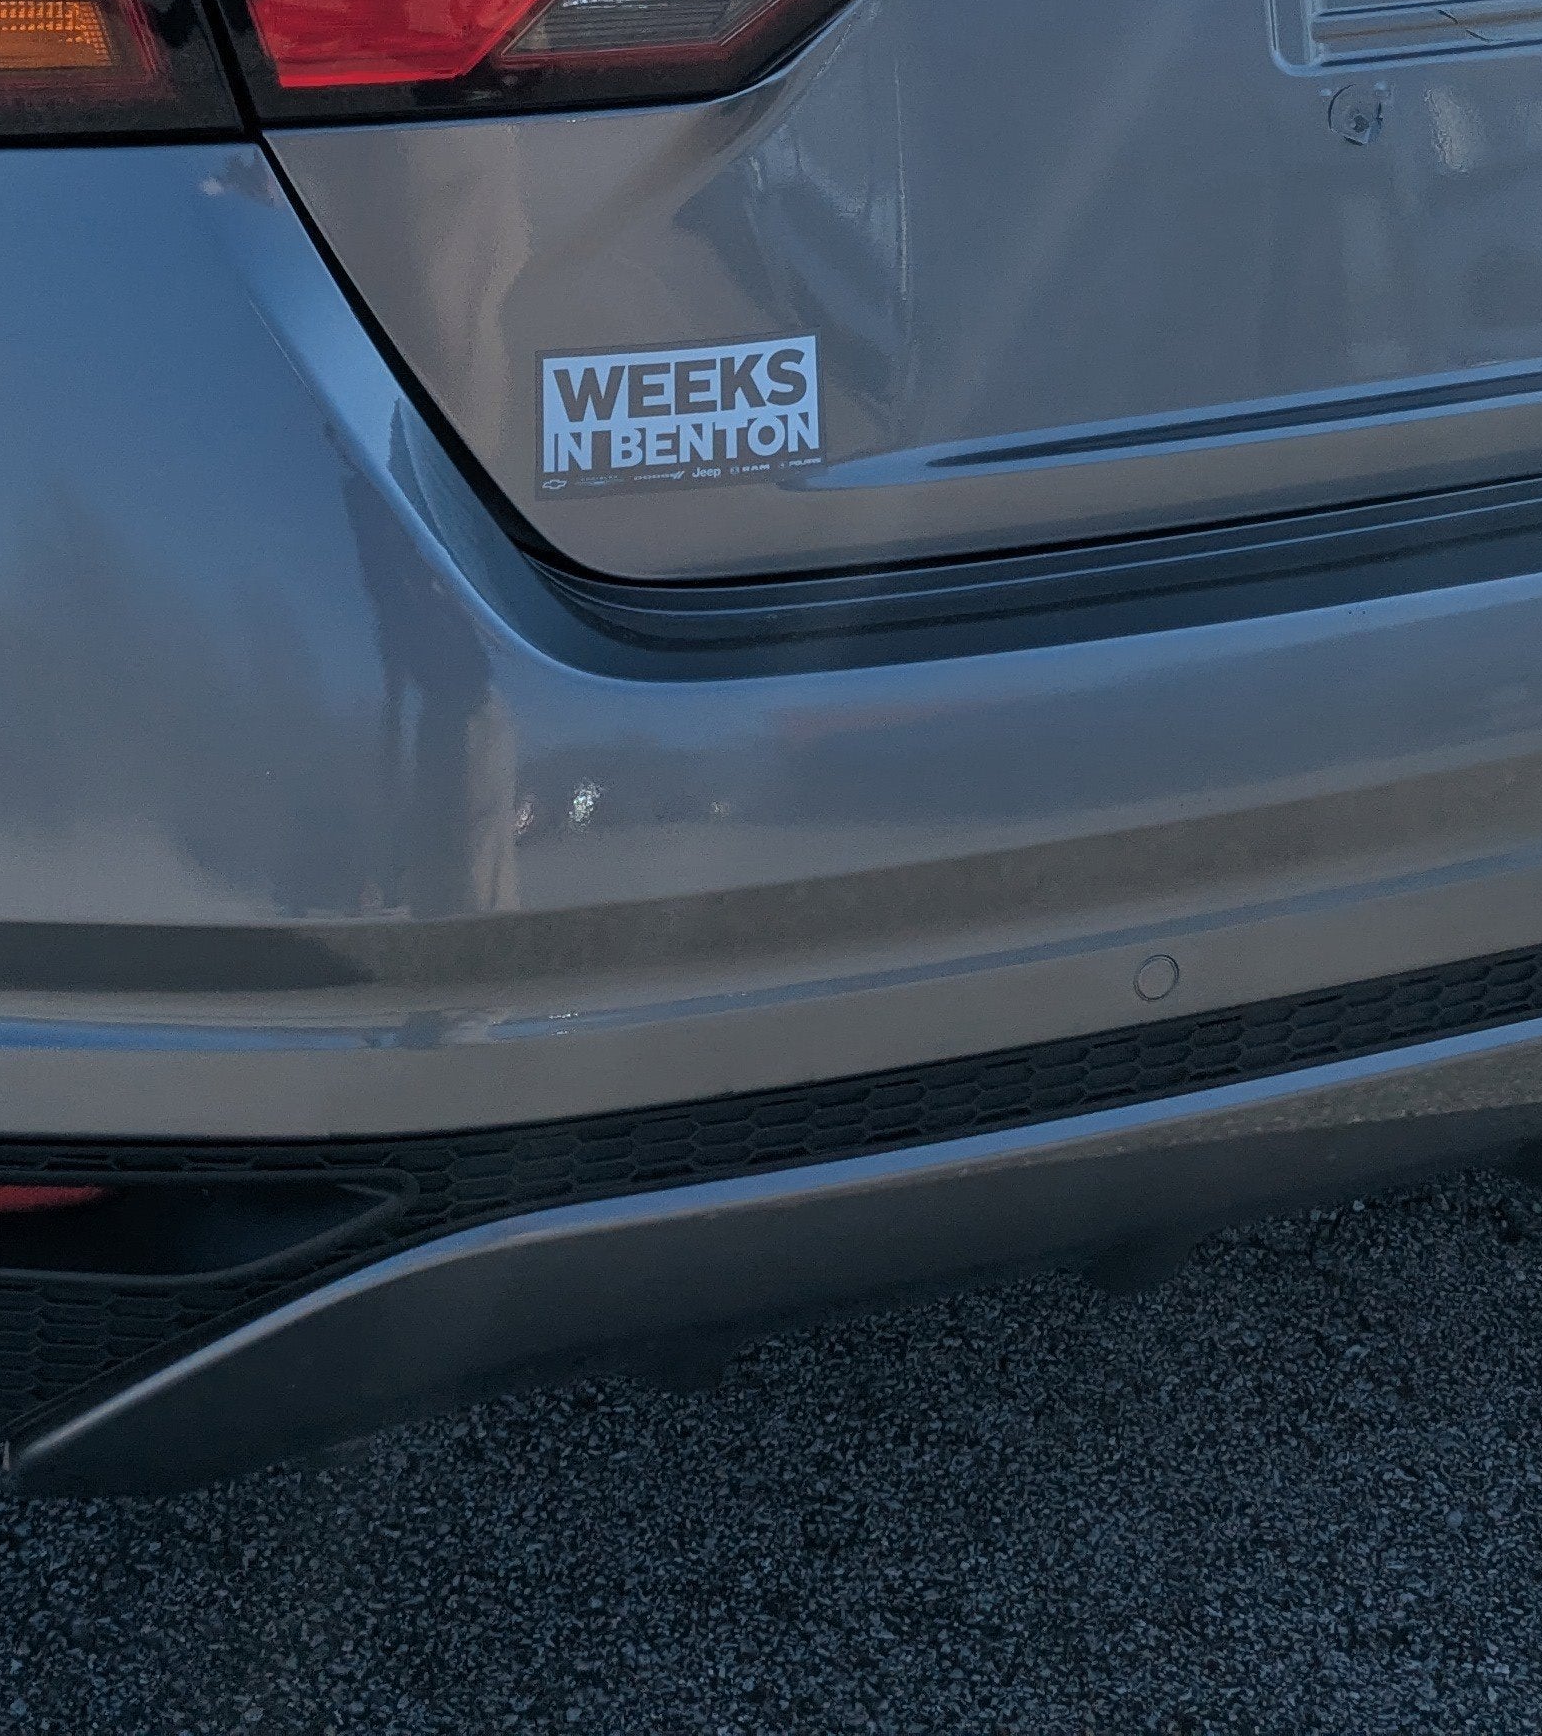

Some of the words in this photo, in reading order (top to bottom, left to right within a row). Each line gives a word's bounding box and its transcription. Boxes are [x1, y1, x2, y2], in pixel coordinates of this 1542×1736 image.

[552, 348, 808, 422] WEEKS
[544, 430, 593, 473] IN
[610, 412, 820, 469] BENTON
[692, 467, 721, 478] Jeep
[742, 464, 770, 472] RAM
